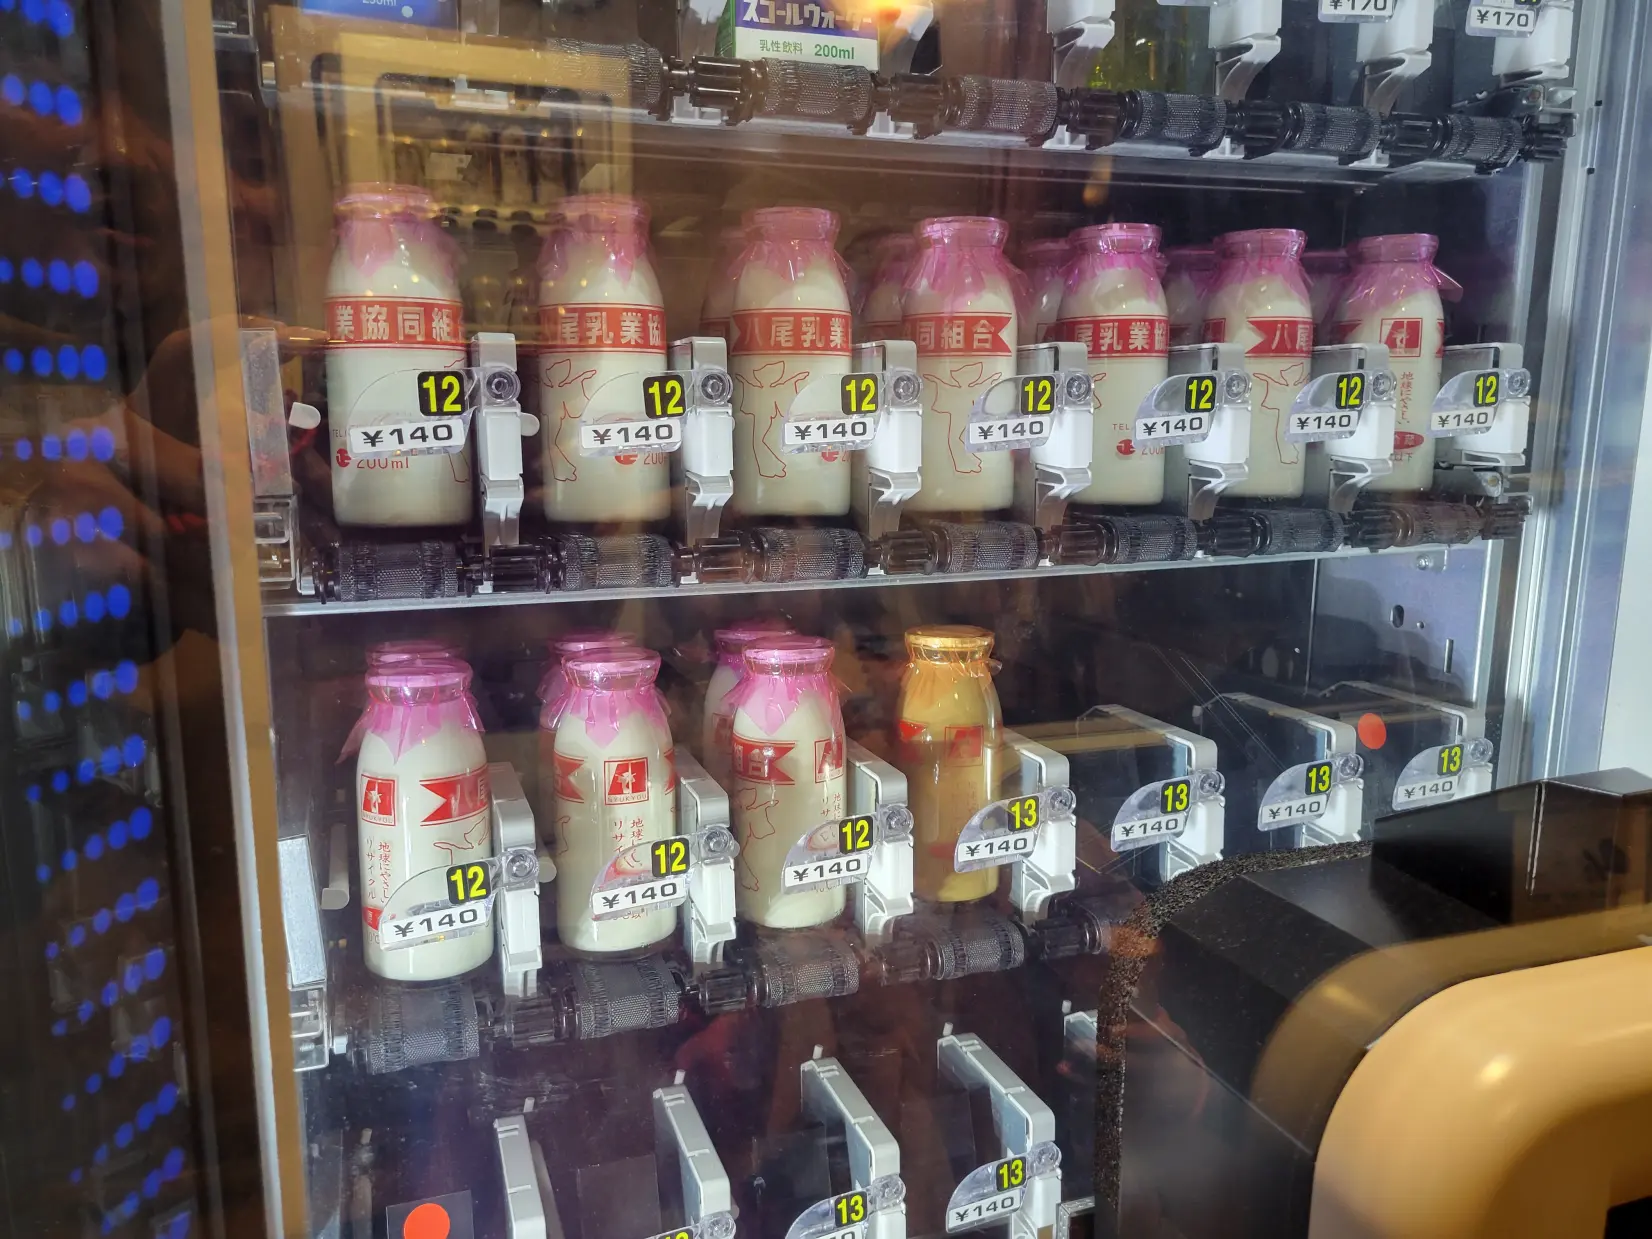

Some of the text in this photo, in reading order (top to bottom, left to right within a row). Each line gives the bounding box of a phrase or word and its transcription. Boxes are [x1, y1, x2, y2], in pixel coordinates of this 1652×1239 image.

[1476, 9, 1529, 28] ¥170
[760, 39, 855, 60] 乳性飲料 200ml
[335, 304, 463, 342] 業協同組
[744, 316, 852, 349] 八尾乳業
[422, 375, 462, 413] 12
[648, 380, 684, 416] 12
[845, 379, 876, 412] 12
[1024, 380, 1052, 412] 12
[1188, 379, 1214, 410] 12
[1338, 376, 1363, 407] 12
[1476, 375, 1498, 405] 12
[794, 421, 868, 440] ¥140
[978, 420, 1044, 440] ¥140
[1113, 423, 1130, 431] TEL
[1143, 416, 1203, 436] ¥140
[1296, 414, 1351, 430] ¥140
[1437, 412, 1489, 428] ¥140
[361, 424, 453, 448] ¥140
[592, 424, 673, 445] ¥140
[1441, 746, 1462, 773] 13
[1308, 765, 1330, 794] 13
[1404, 780, 1453, 799] ¥140
[1164, 783, 1188, 812] 13
[1269, 801, 1321, 819] ¥140
[1011, 798, 1037, 829] 13
[1121, 818, 1179, 837] ¥140
[842, 819, 870, 851] 12
[965, 837, 1028, 857] ¥140
[655, 841, 687, 874] 12
[793, 858, 861, 882] ¥140
[450, 865, 487, 901] 12
[602, 882, 677, 909] ¥140
[393, 908, 478, 938] ¥140
[1000, 1159, 1023, 1189] 13
[837, 1195, 864, 1225] 13
[955, 1196, 1015, 1222] ¥140
